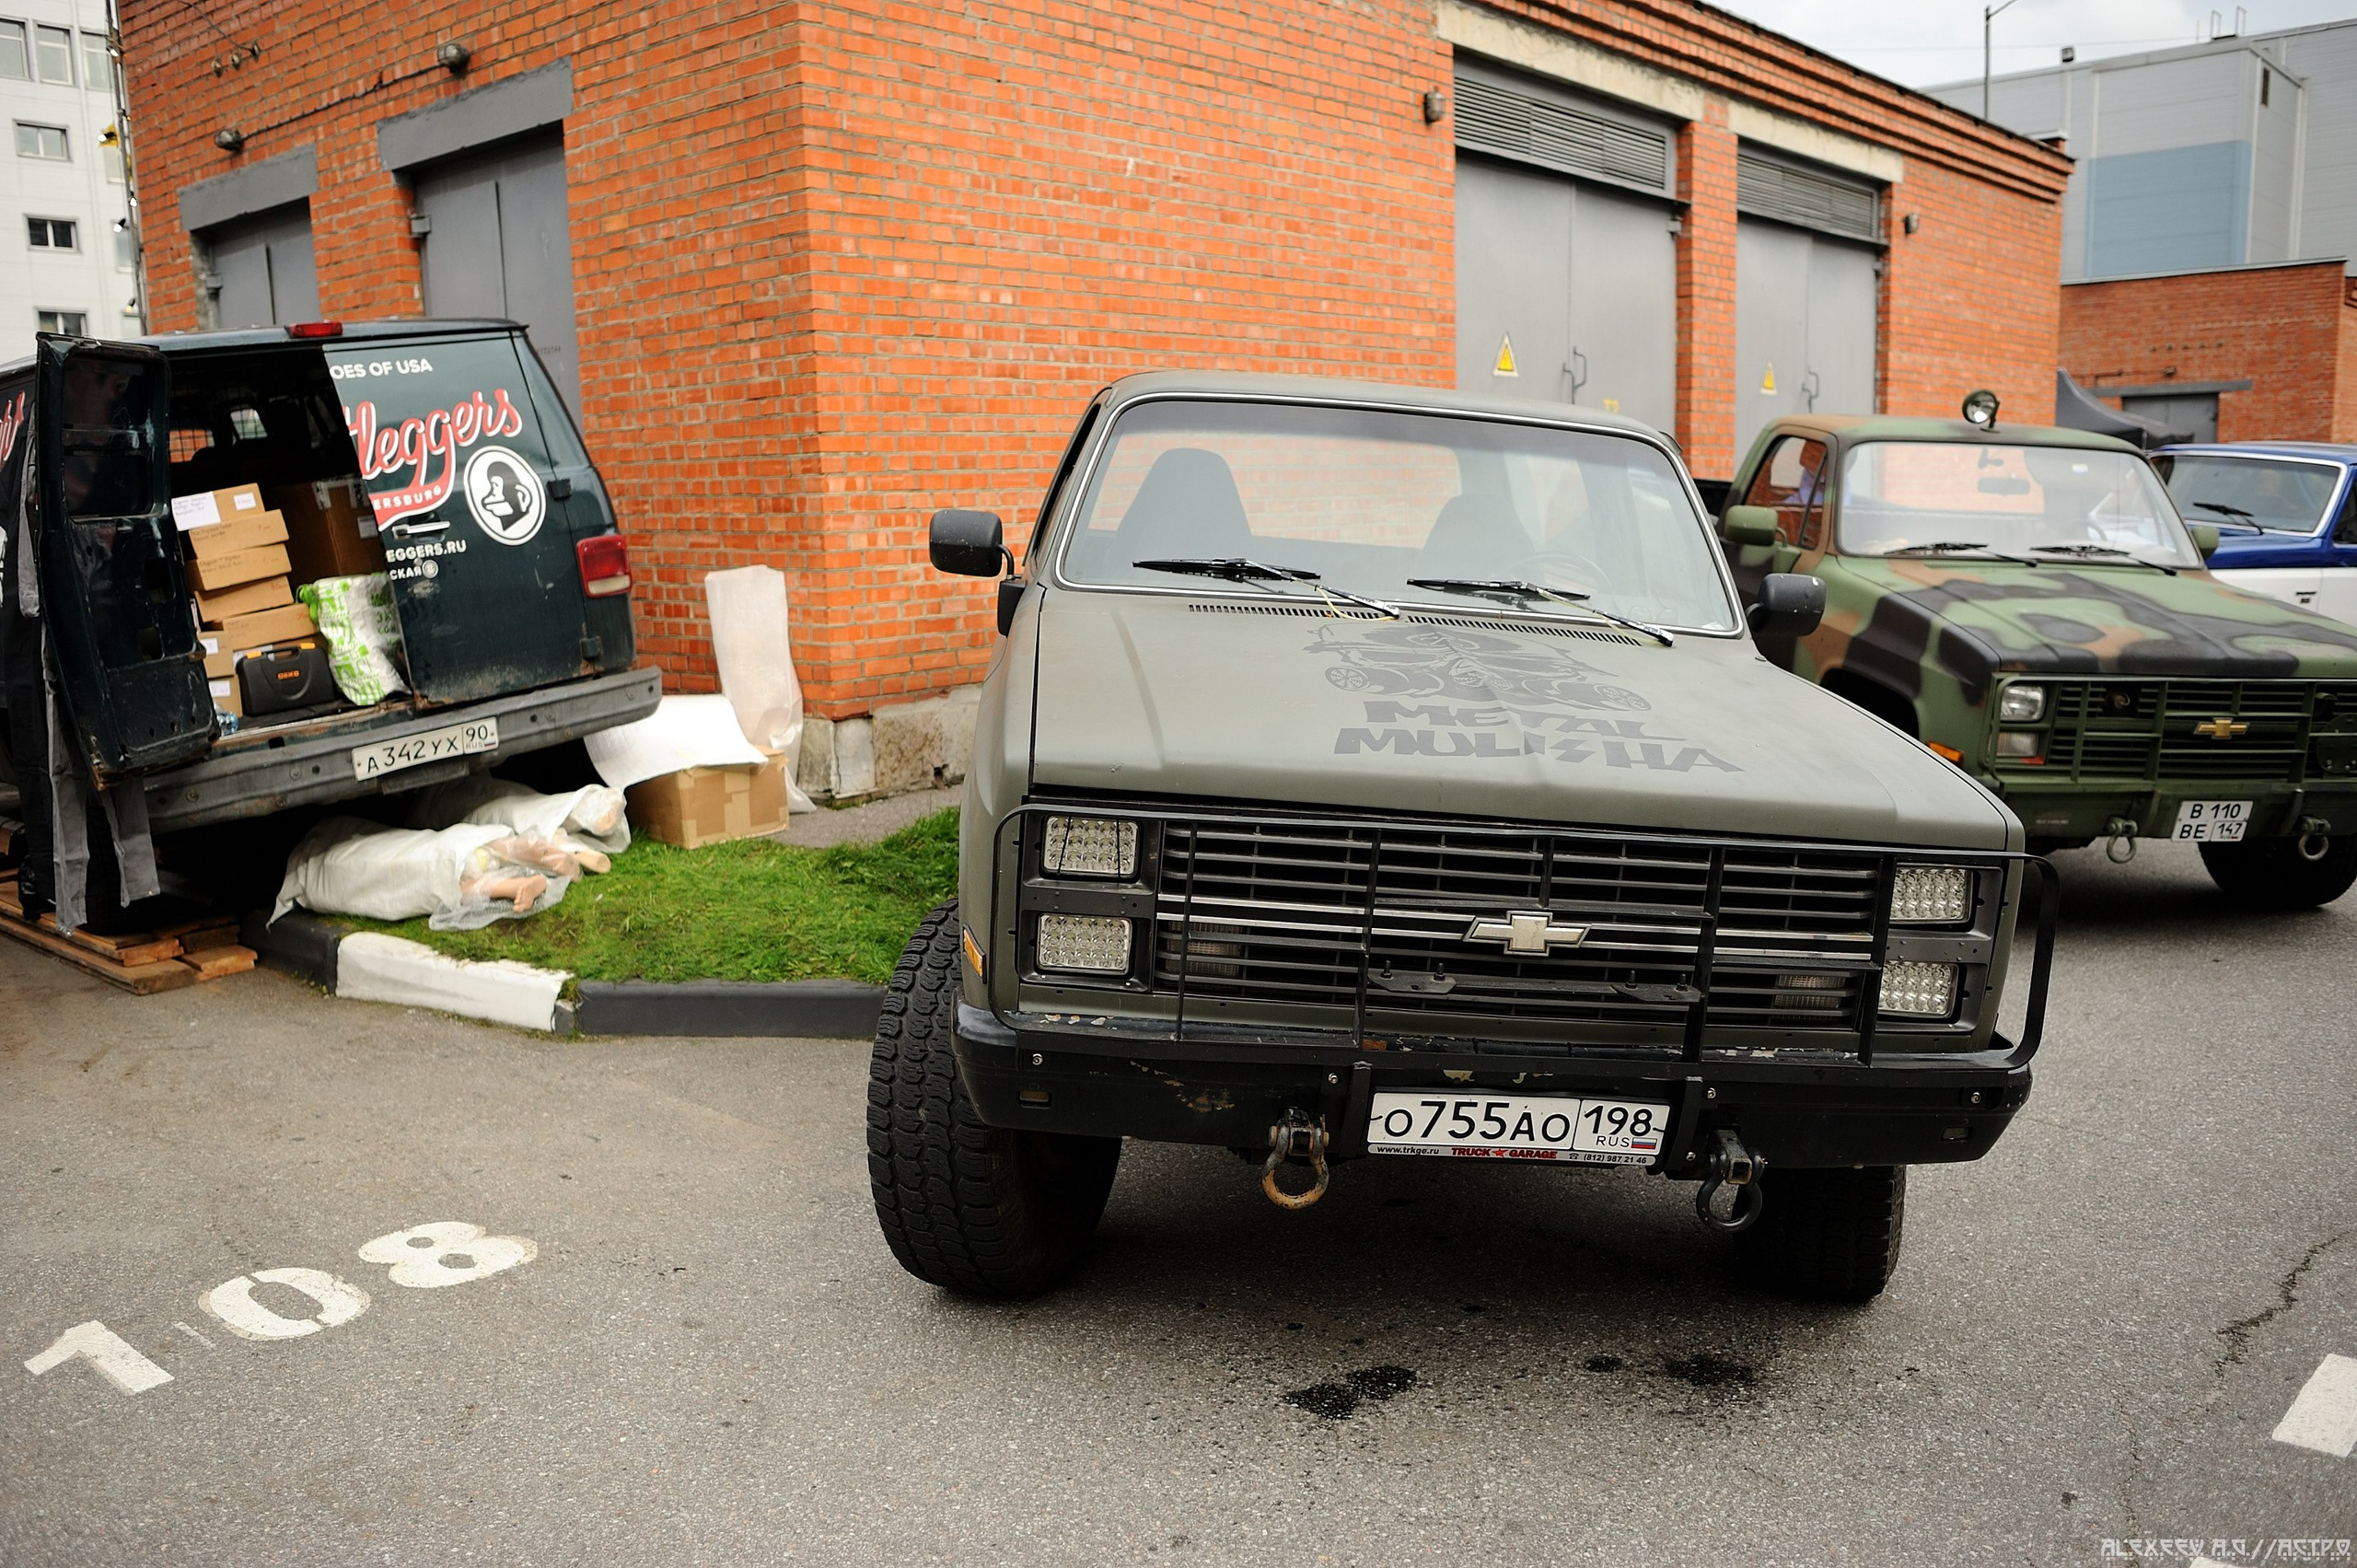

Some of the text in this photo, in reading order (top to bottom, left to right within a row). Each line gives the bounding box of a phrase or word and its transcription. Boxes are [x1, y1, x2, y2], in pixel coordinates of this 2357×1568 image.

[369, 361, 394, 377] OF
[396, 357, 434, 375] USA
[1364, 700, 1687, 741] METAL
[466, 725, 489, 742] 90
[1333, 726, 1746, 773] MULISHA
[2211, 803, 2241, 819] 110
[2218, 822, 2243, 835] 147
[1584, 1105, 1654, 1136] 198
[1596, 1135, 1631, 1148] RUS
[1451, 1147, 1492, 1156] TRUCK
[1509, 1149, 1558, 1159] GARAGE
[1584, 1153, 1605, 1162] (812)
[1607, 1155, 1622, 1163] 987
